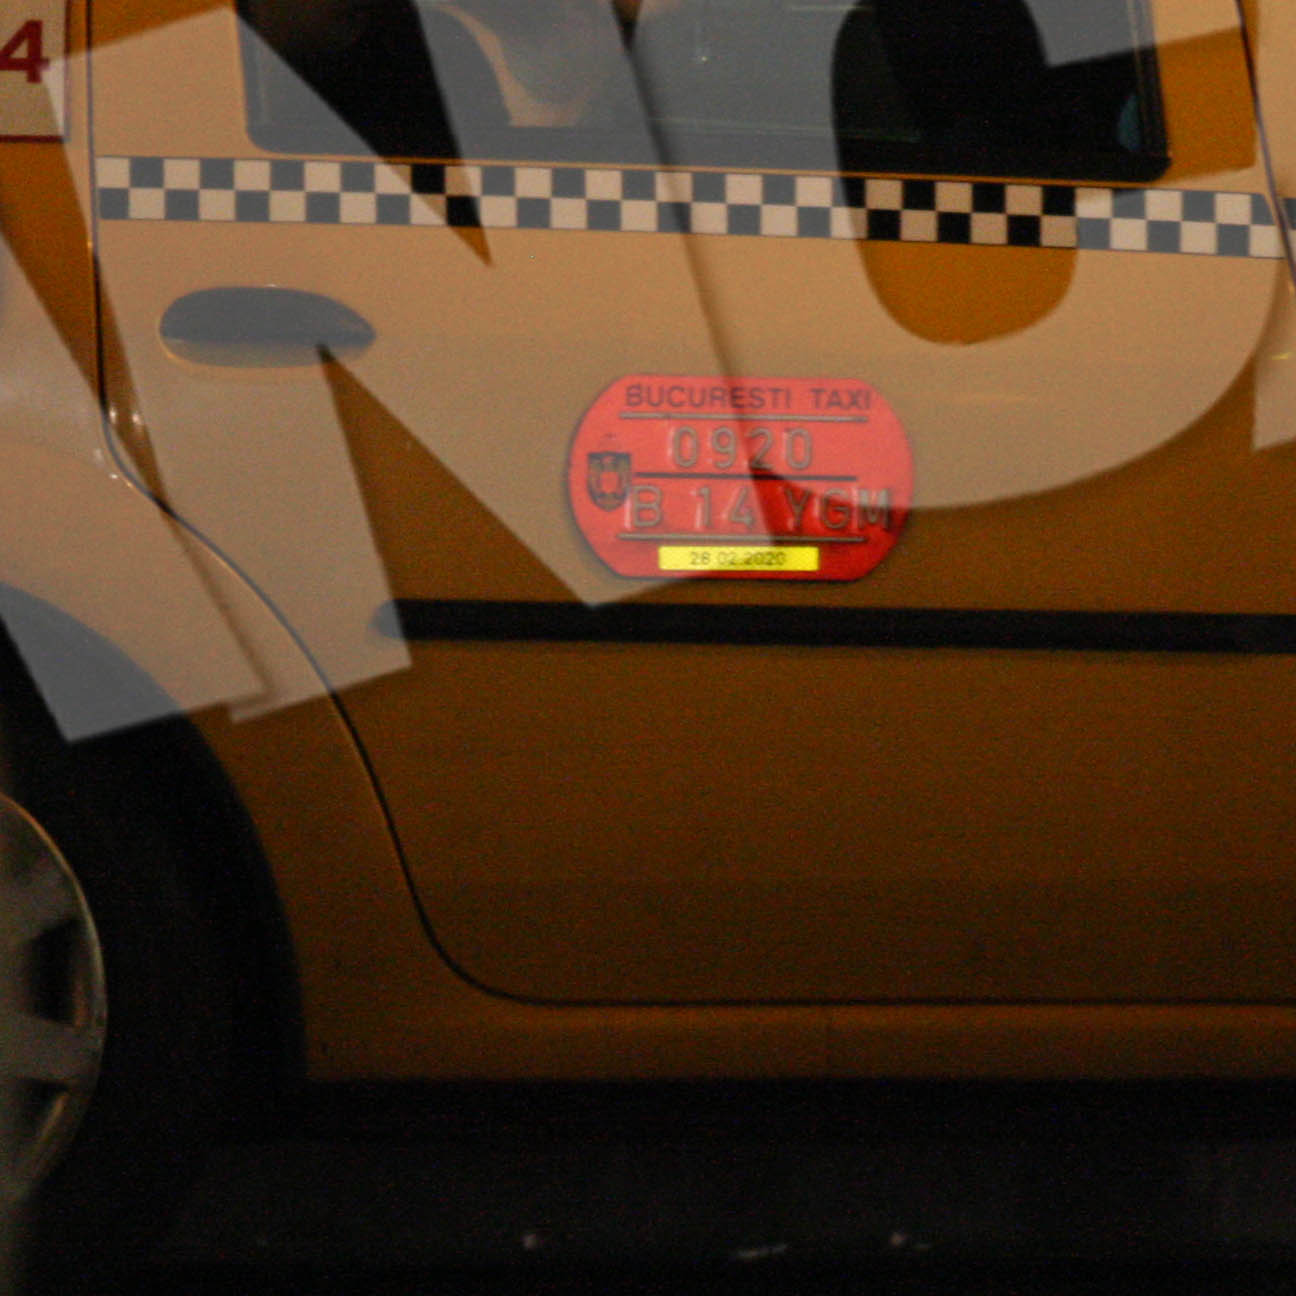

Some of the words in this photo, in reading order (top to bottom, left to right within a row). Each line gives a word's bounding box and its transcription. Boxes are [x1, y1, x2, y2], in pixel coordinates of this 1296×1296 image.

[625, 384, 792, 410] BUCURESTI
[810, 387, 872, 412] TAXI
[670, 424, 814, 471] 0920
[625, 484, 664, 530] B
[690, 486, 757, 531] 14
